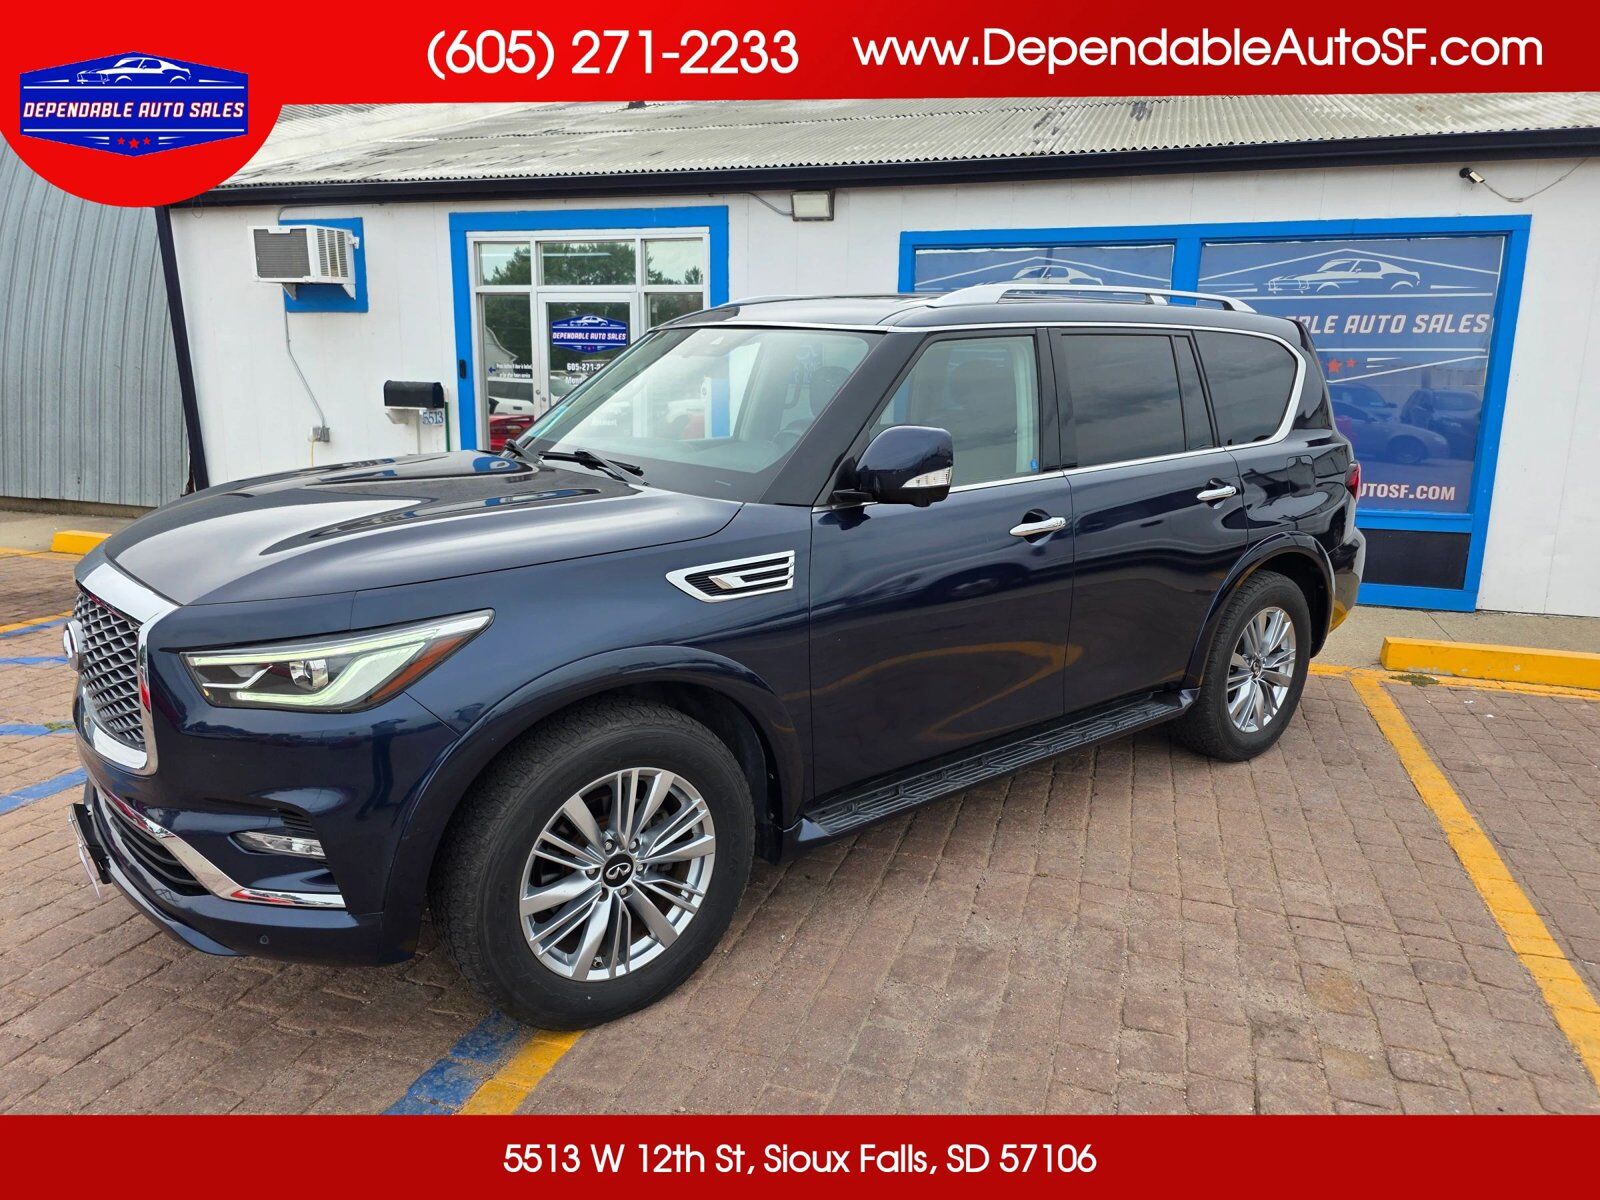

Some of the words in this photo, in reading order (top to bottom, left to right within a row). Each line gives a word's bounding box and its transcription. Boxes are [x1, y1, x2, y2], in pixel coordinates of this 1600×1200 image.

[1343, 314, 1407, 334] AUTO
[1412, 313, 1490, 334] SALES
[552, 332, 590, 340] DEPENDABLE
[590, 332, 606, 341] AUTO
[607, 332, 626, 341] SALES
[422, 411, 444, 425] 5513
